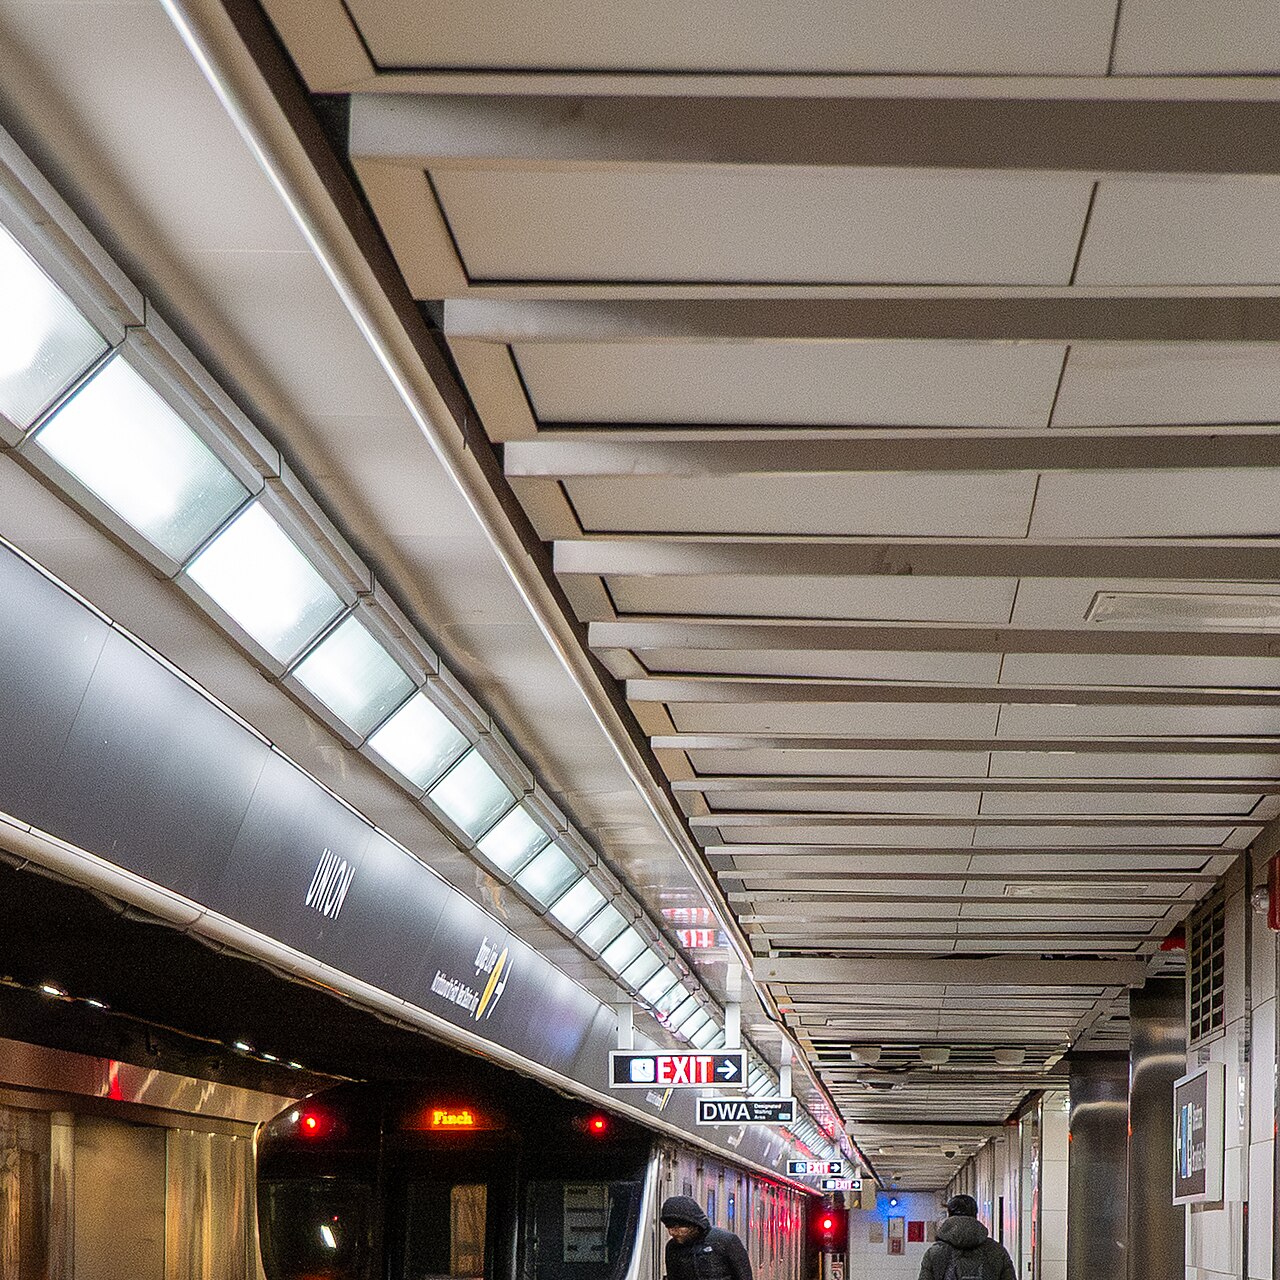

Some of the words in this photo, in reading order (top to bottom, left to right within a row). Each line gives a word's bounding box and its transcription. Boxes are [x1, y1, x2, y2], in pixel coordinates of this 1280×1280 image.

[305, 847, 356, 920] UNION
[657, 1056, 712, 1083] EXIT
[433, 1111, 474, 1125] Finch
[703, 1103, 751, 1120] DWA
[807, 1161, 830, 1174] EXIT
